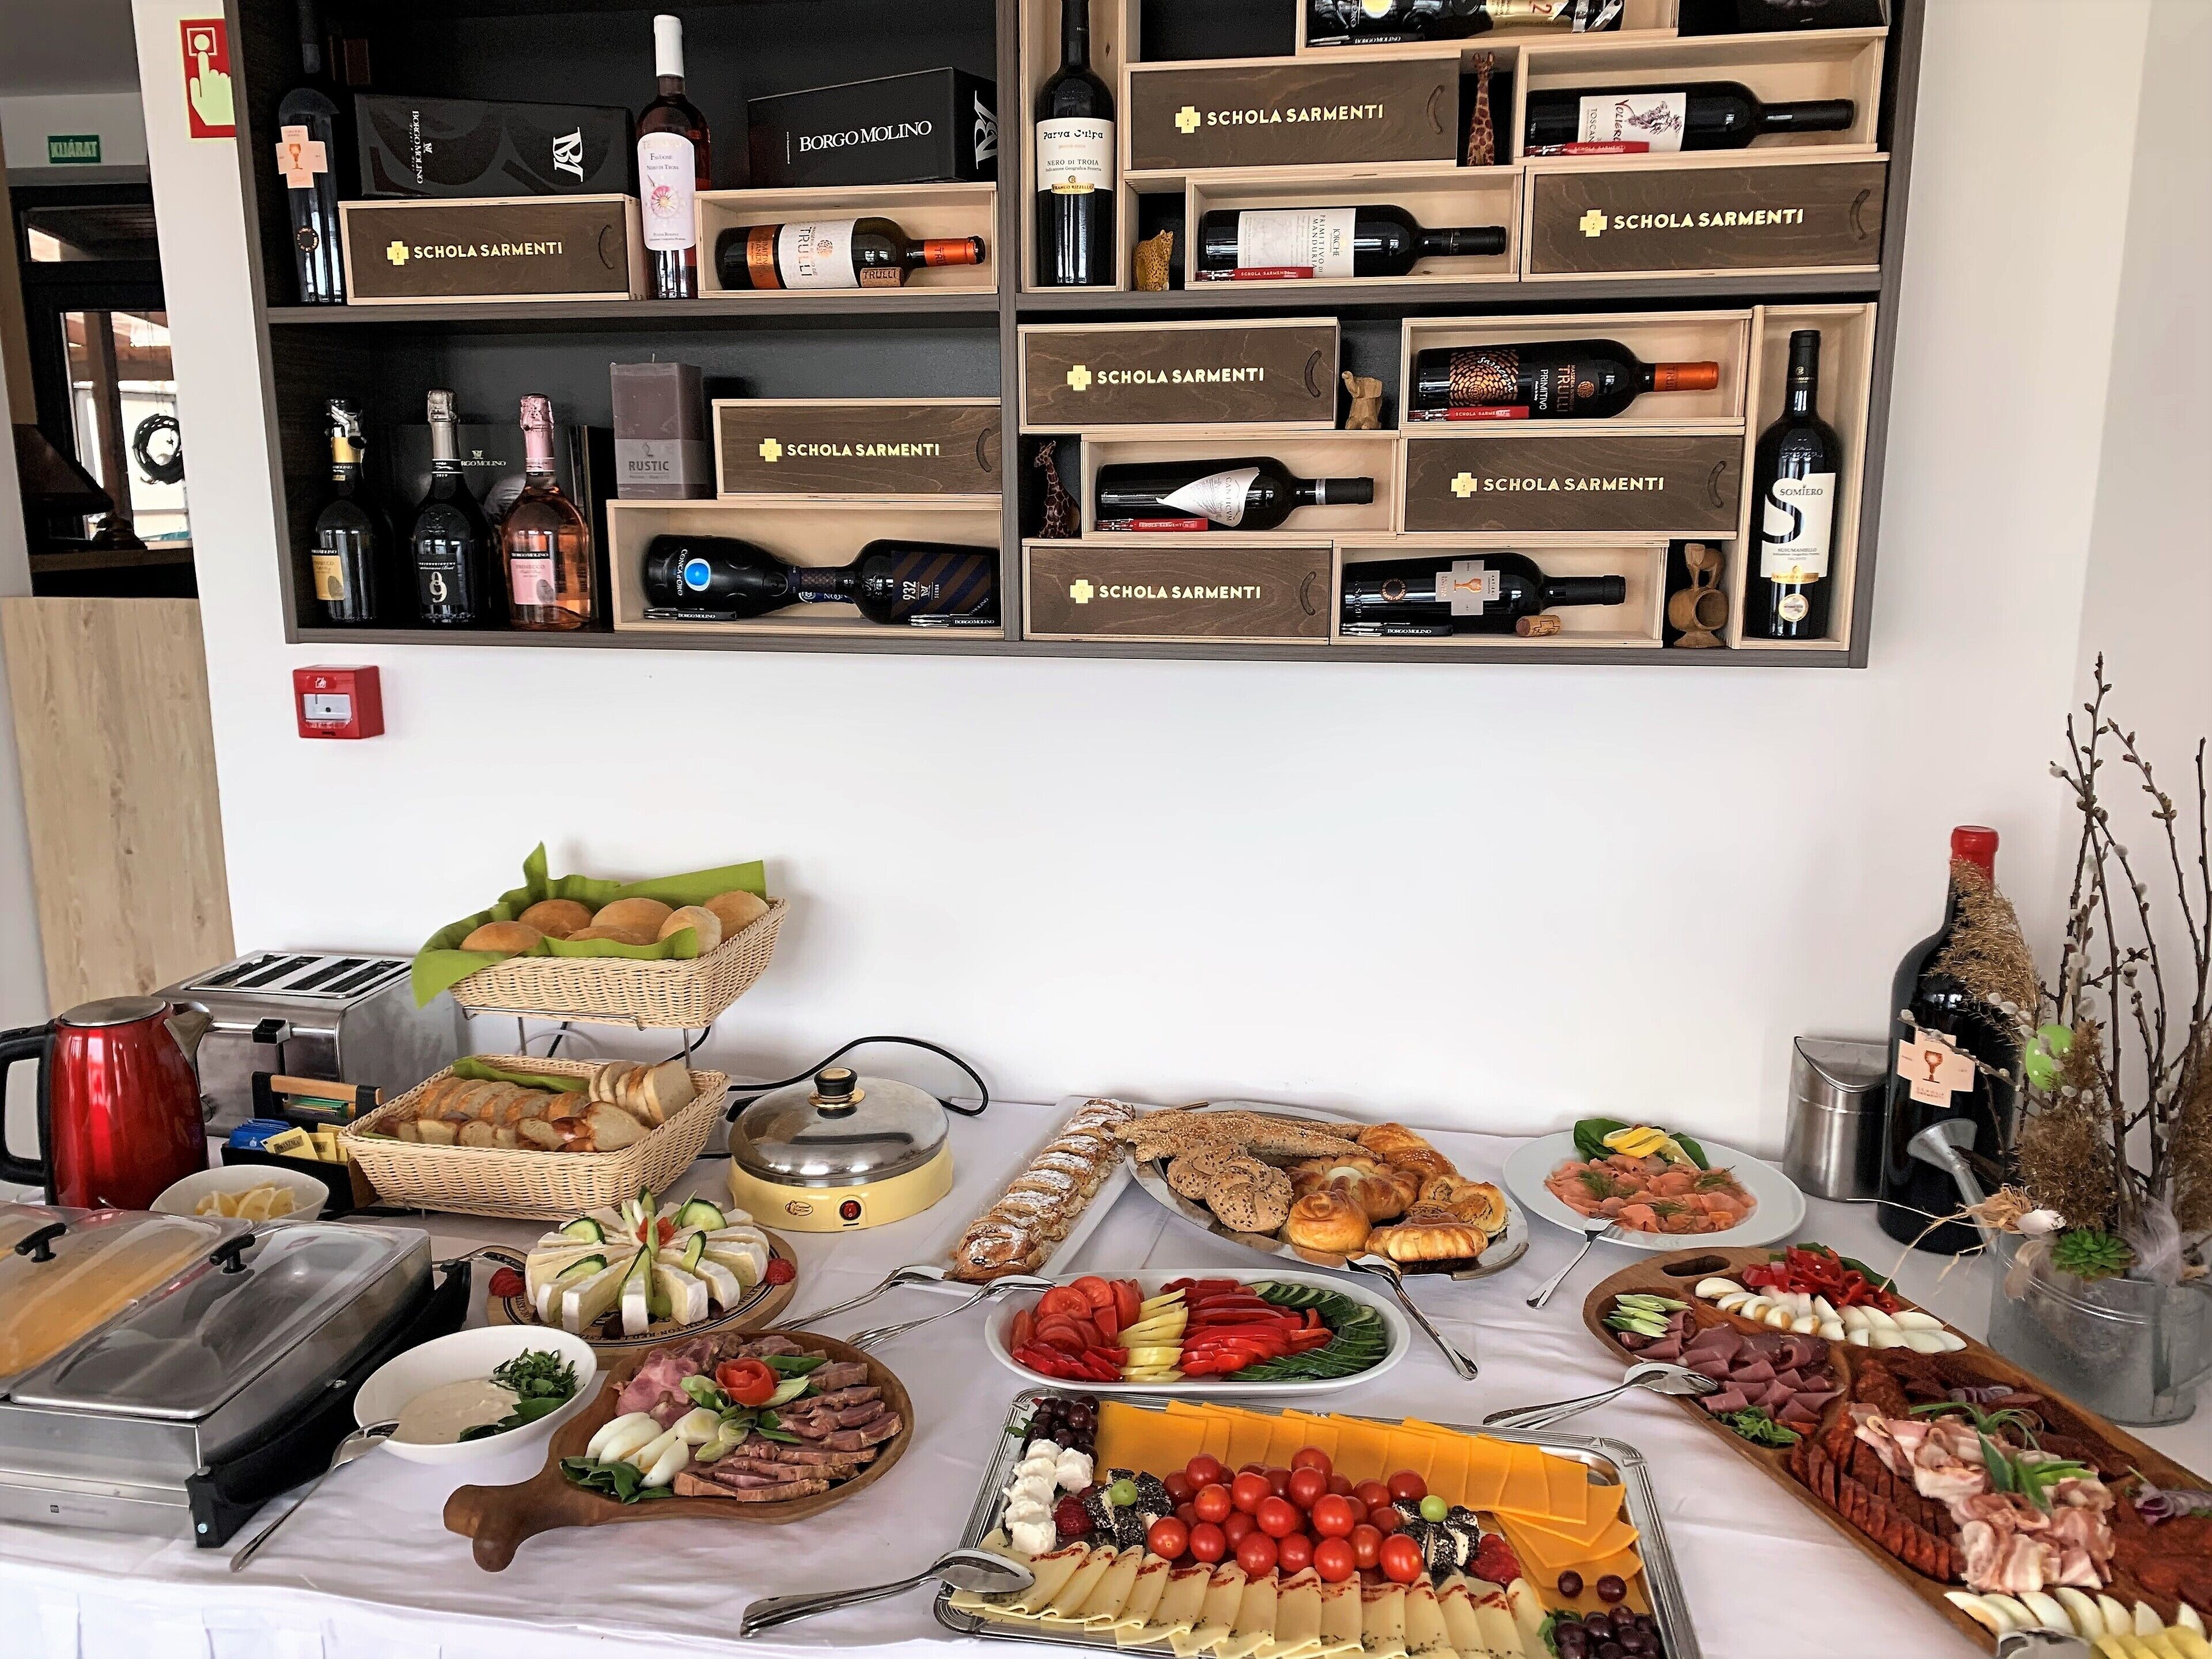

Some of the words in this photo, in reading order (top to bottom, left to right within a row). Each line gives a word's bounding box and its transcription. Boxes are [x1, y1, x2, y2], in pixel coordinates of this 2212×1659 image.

[1207, 109, 1282, 126] SCHOLA
[1286, 104, 1382, 123] SARMENTI
[1588, 108, 1597, 142] TOSCAN
[412, 111, 421, 145] BORGO
[800, 131, 858, 152] BORGO
[860, 120, 932, 144] MOLINO
[414, 145, 424, 184] MOLINO
[1614, 213, 1694, 230] SCHOLA
[1698, 209, 1804, 227] SARMENTI
[414, 245, 478, 259] SCHOLA
[480, 242, 562, 257] SARMENTI
[1098, 370, 1168, 384] SCHOLA
[1172, 368, 1264, 384] SARMENTI
[1539, 369, 1549, 410] PRIMITIVO
[787, 444, 852, 456] SCHOLA
[855, 444, 940, 457] SARMENTI
[628, 460, 669, 471] RUSTIC
[1483, 478, 1560, 491] SCHOLA
[1563, 474, 1664, 491] SARMENTI
[902, 581, 917, 601] 932
[1100, 586, 1168, 599] SCHOLA
[1171, 586, 1261, 599] SARMENTI
